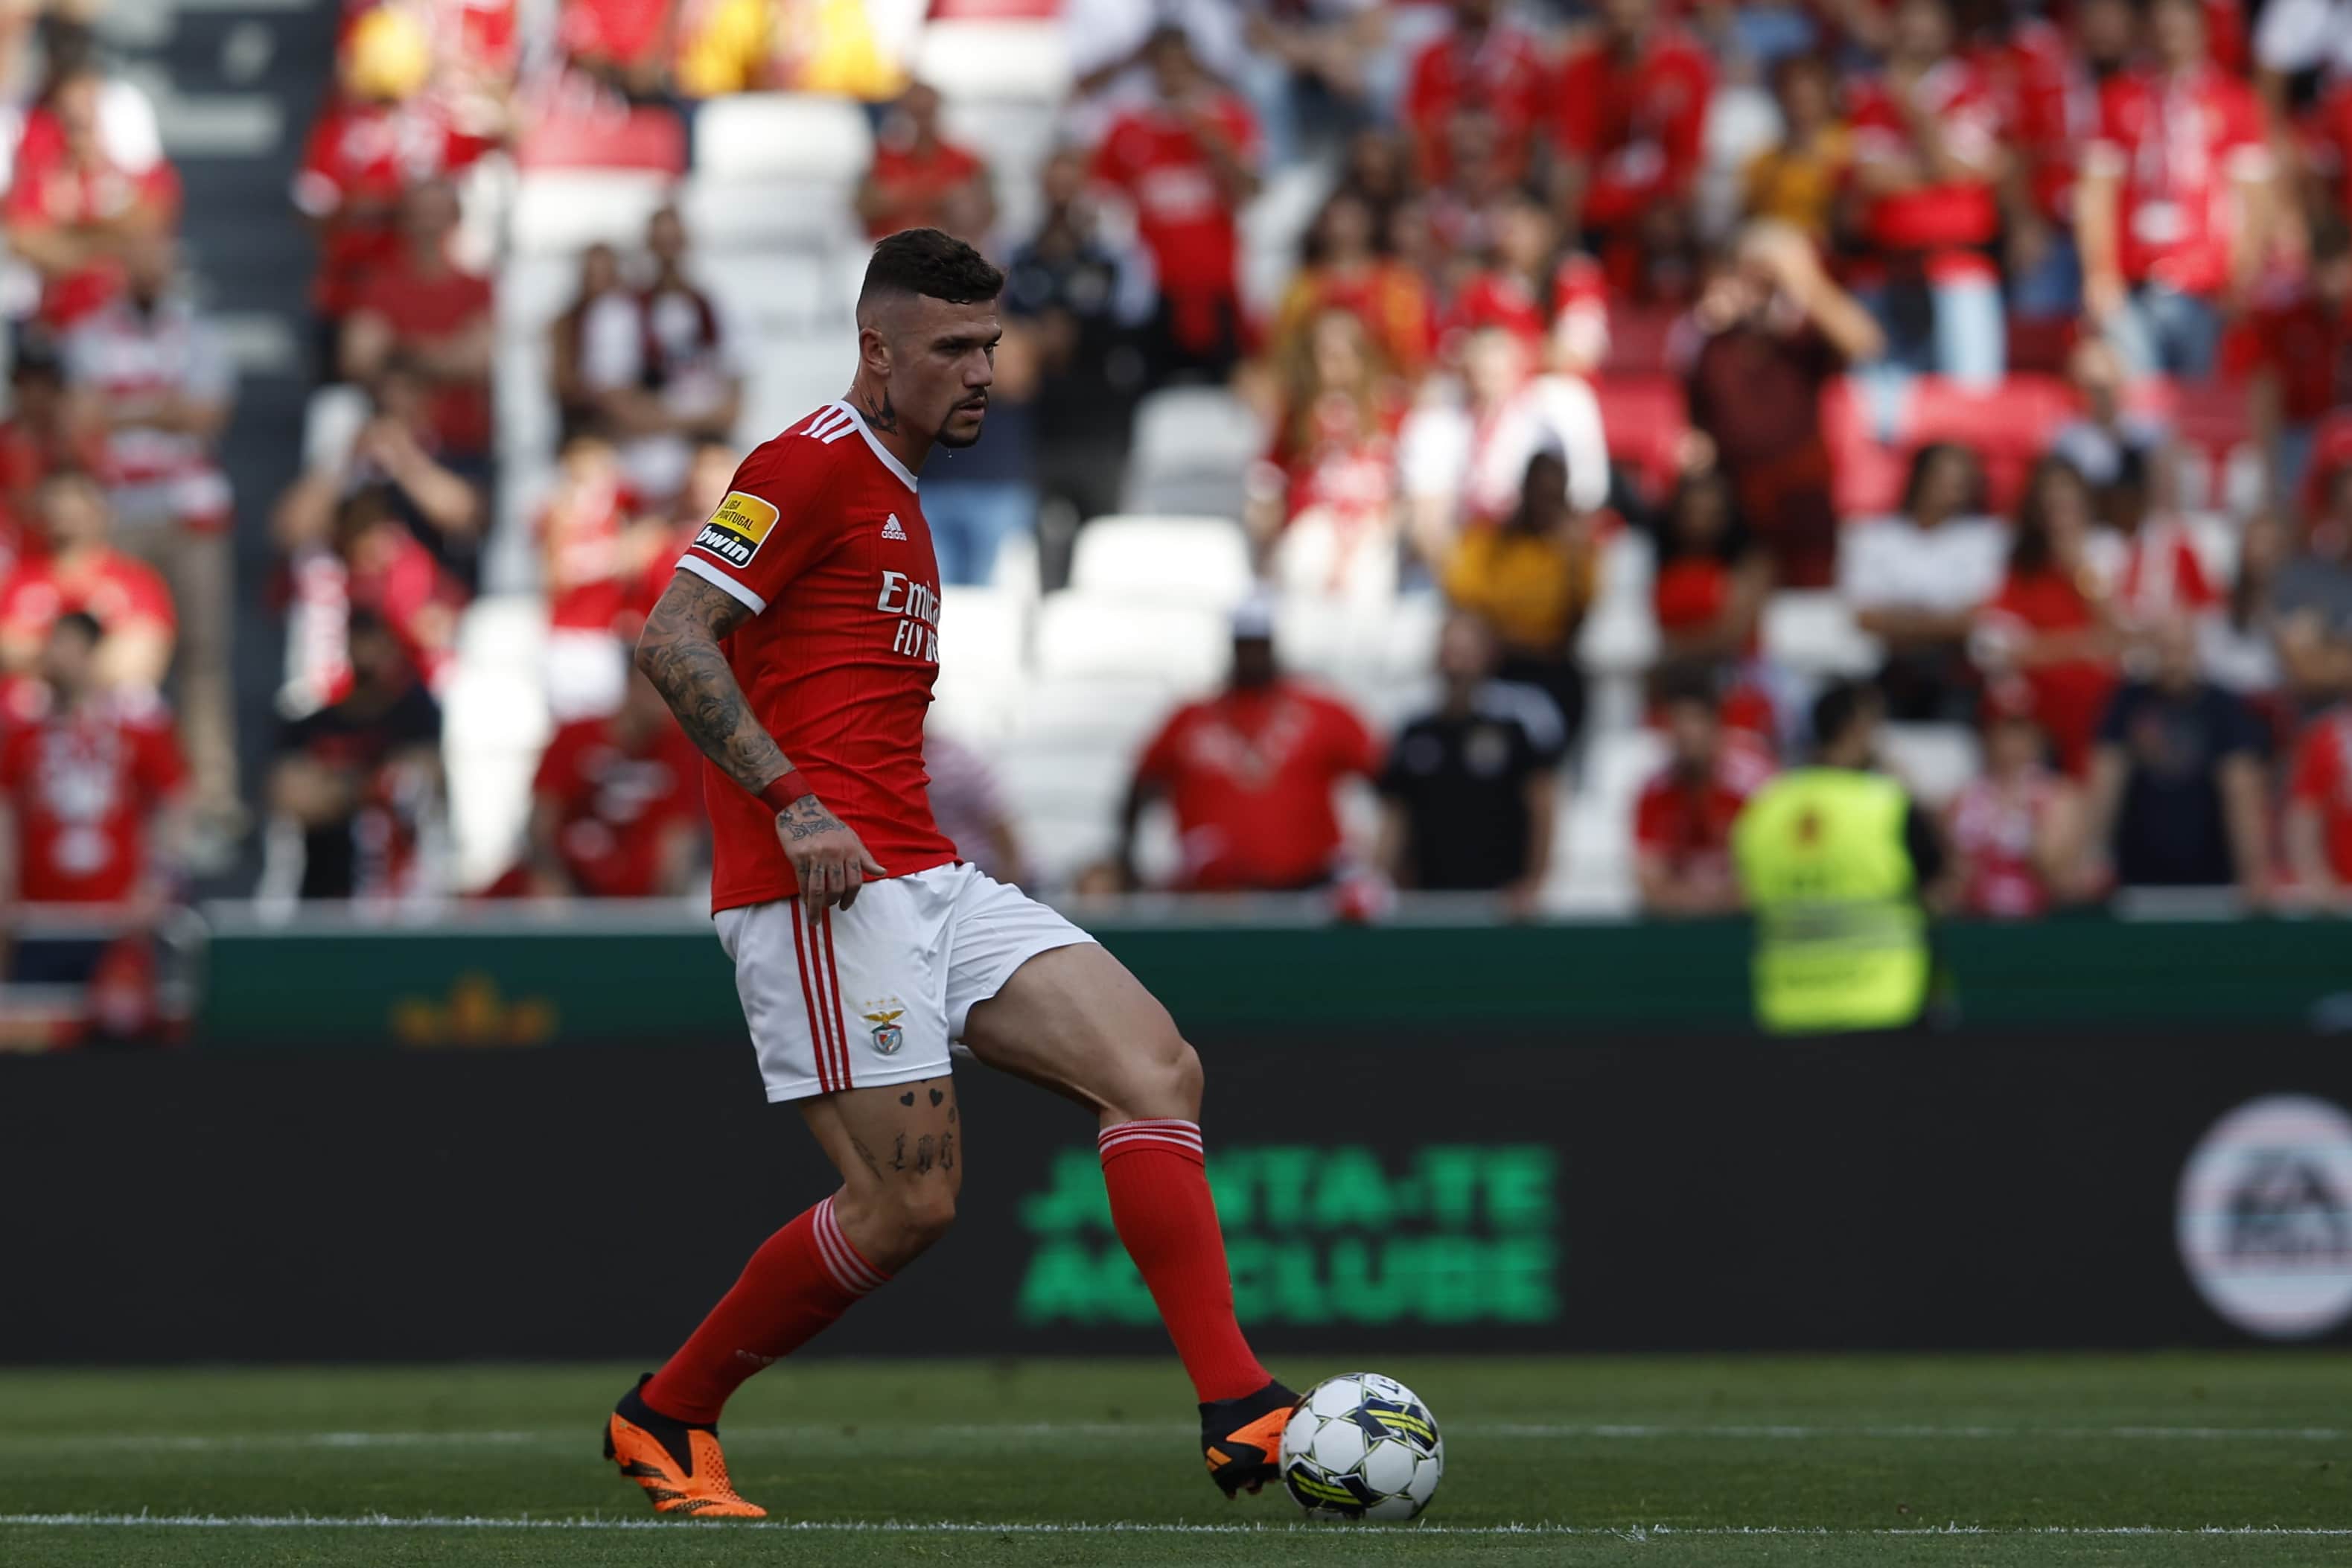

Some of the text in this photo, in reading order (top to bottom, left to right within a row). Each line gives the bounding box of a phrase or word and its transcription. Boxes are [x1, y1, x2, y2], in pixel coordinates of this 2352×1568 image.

[724, 500, 742, 510] LIGA
[716, 509, 753, 532] PORTUGAL
[882, 529, 908, 542] adidas
[695, 525, 750, 562] bwin
[893, 619, 923, 658] FLY
[1016, 1142, 1561, 1230] JNTA-TE
